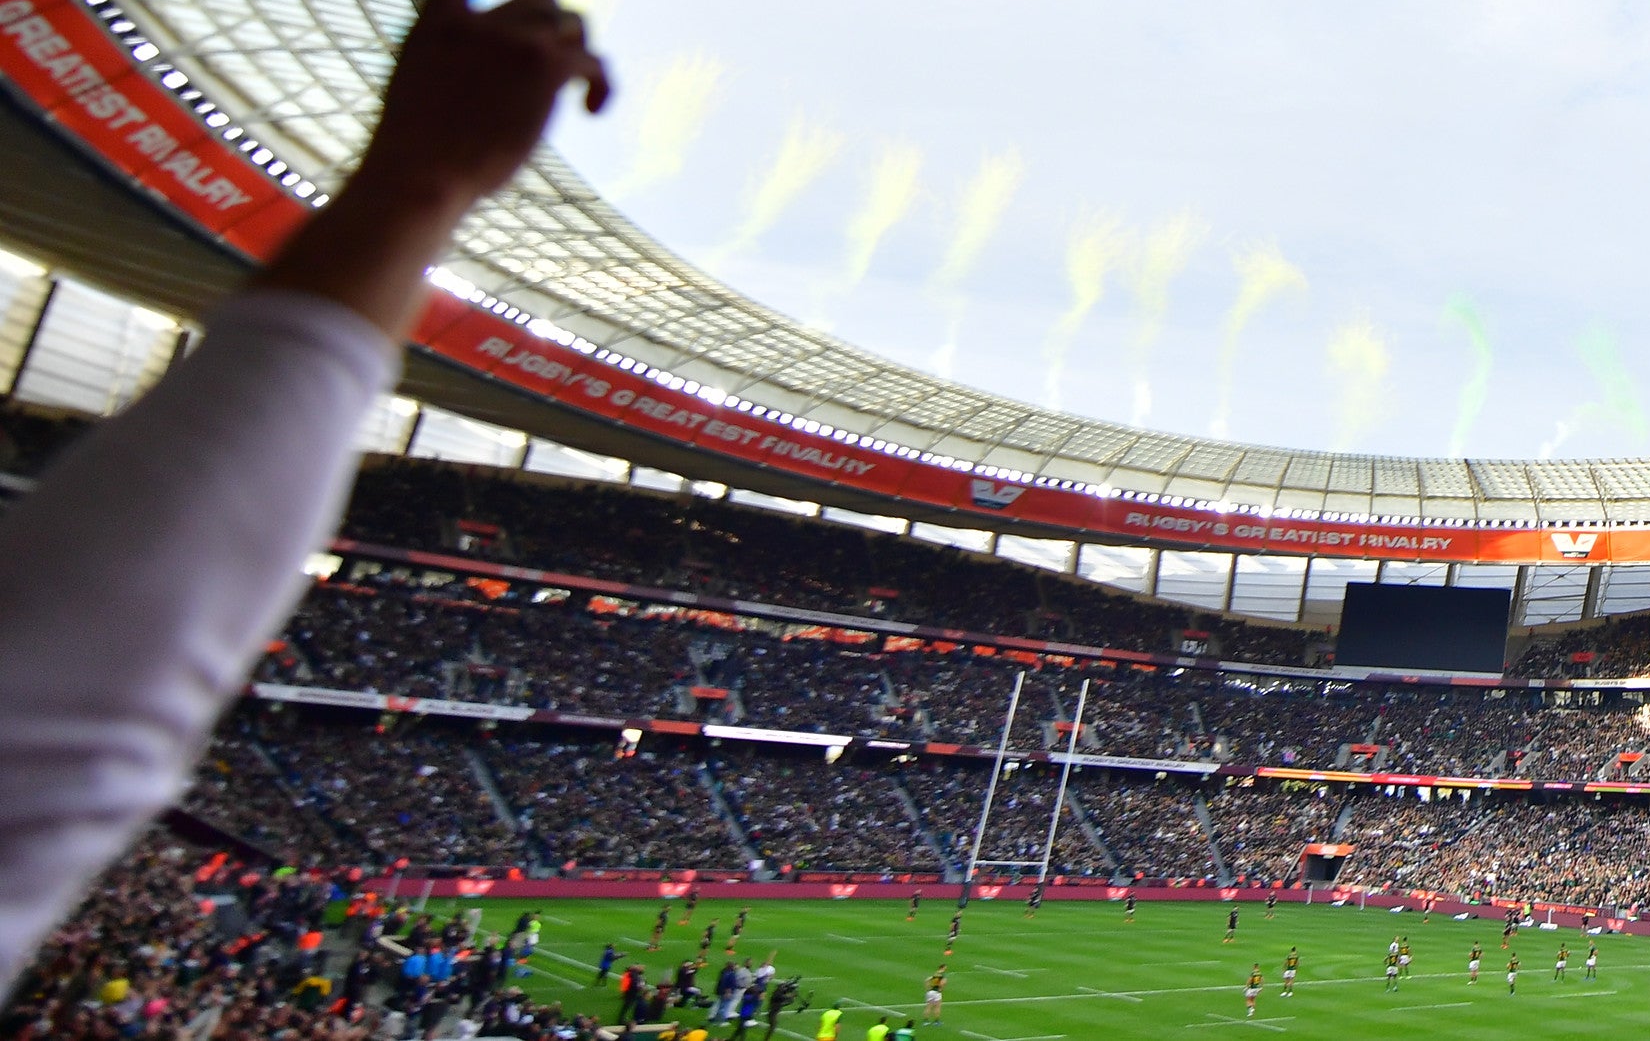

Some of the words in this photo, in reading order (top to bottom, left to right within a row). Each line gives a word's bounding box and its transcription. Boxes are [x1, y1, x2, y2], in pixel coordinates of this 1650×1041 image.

[127, 123, 253, 210] RIVALRY
[478, 336, 609, 399] RUGBY'S
[610, 389, 759, 446] GREATEST
[760, 434, 877, 476] RIVALRY
[1125, 511, 1229, 537] RUGBY'S
[1234, 524, 1355, 547] GREATEST
[1360, 532, 1453, 551] RIVALRY
